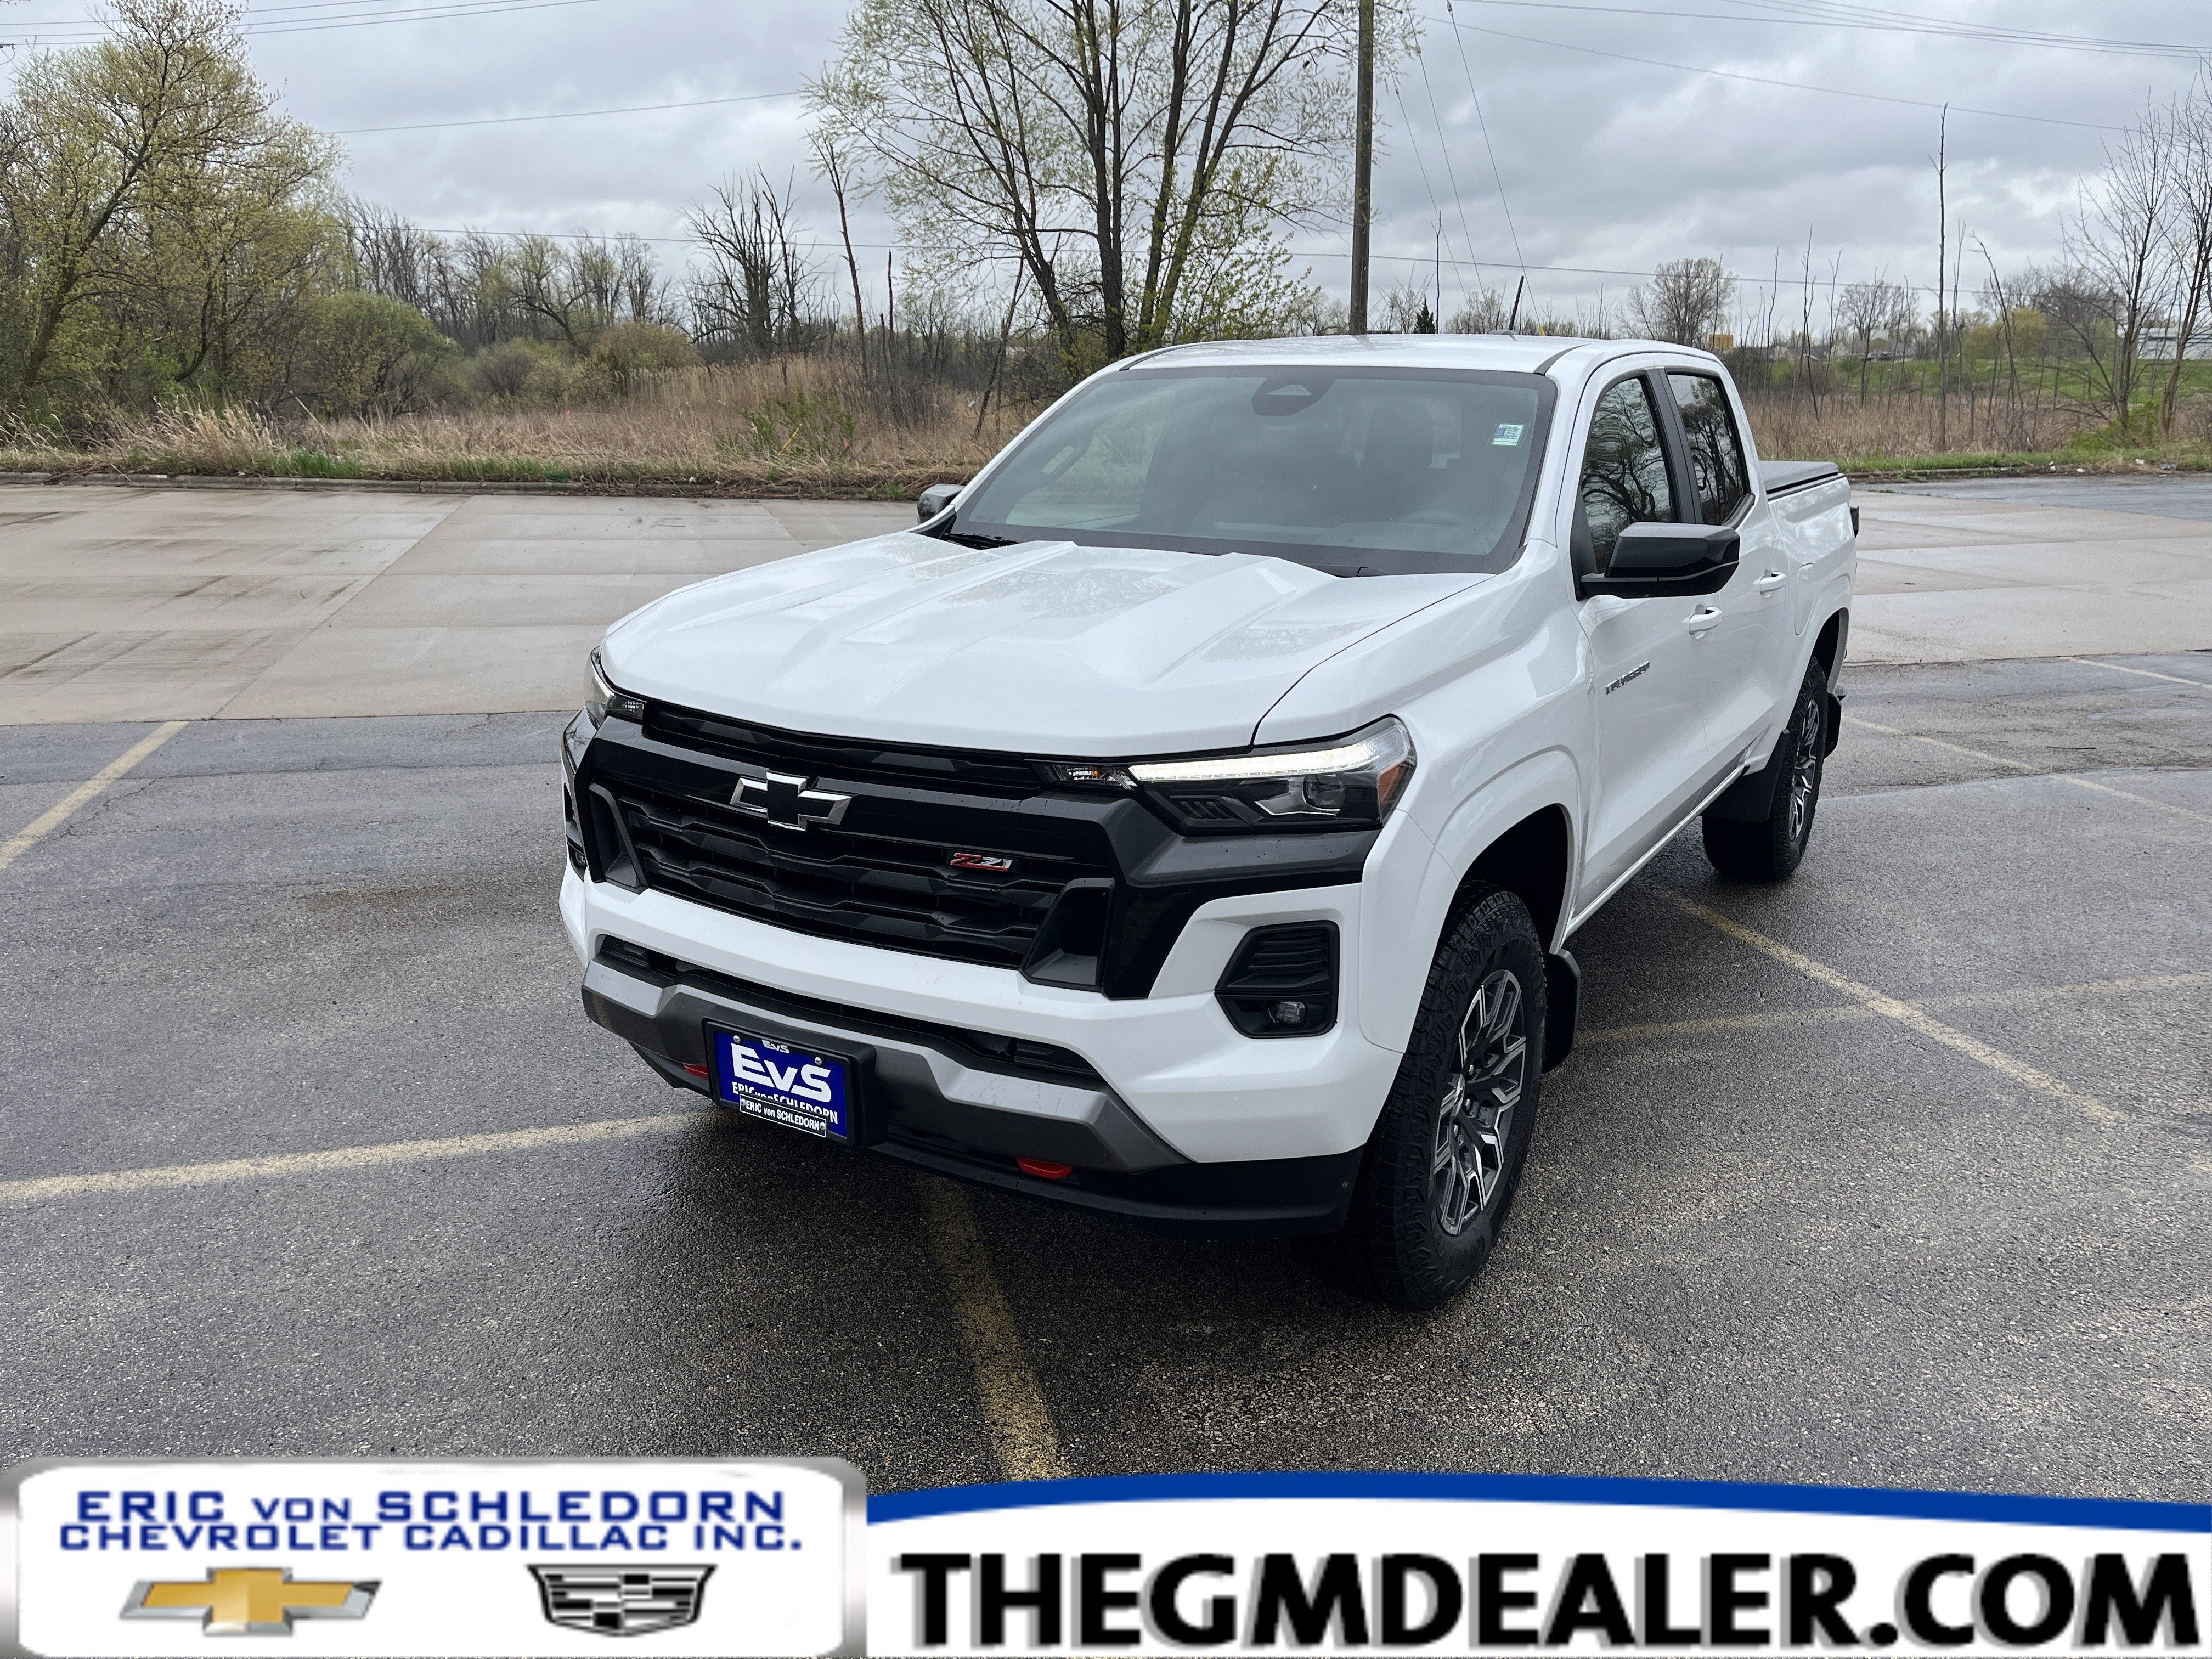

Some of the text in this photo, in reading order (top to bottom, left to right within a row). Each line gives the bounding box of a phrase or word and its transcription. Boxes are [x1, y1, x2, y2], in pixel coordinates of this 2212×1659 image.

[950, 853, 1013, 872] Z71
[746, 1101, 820, 1131] ERIC von SCHLEDORN
